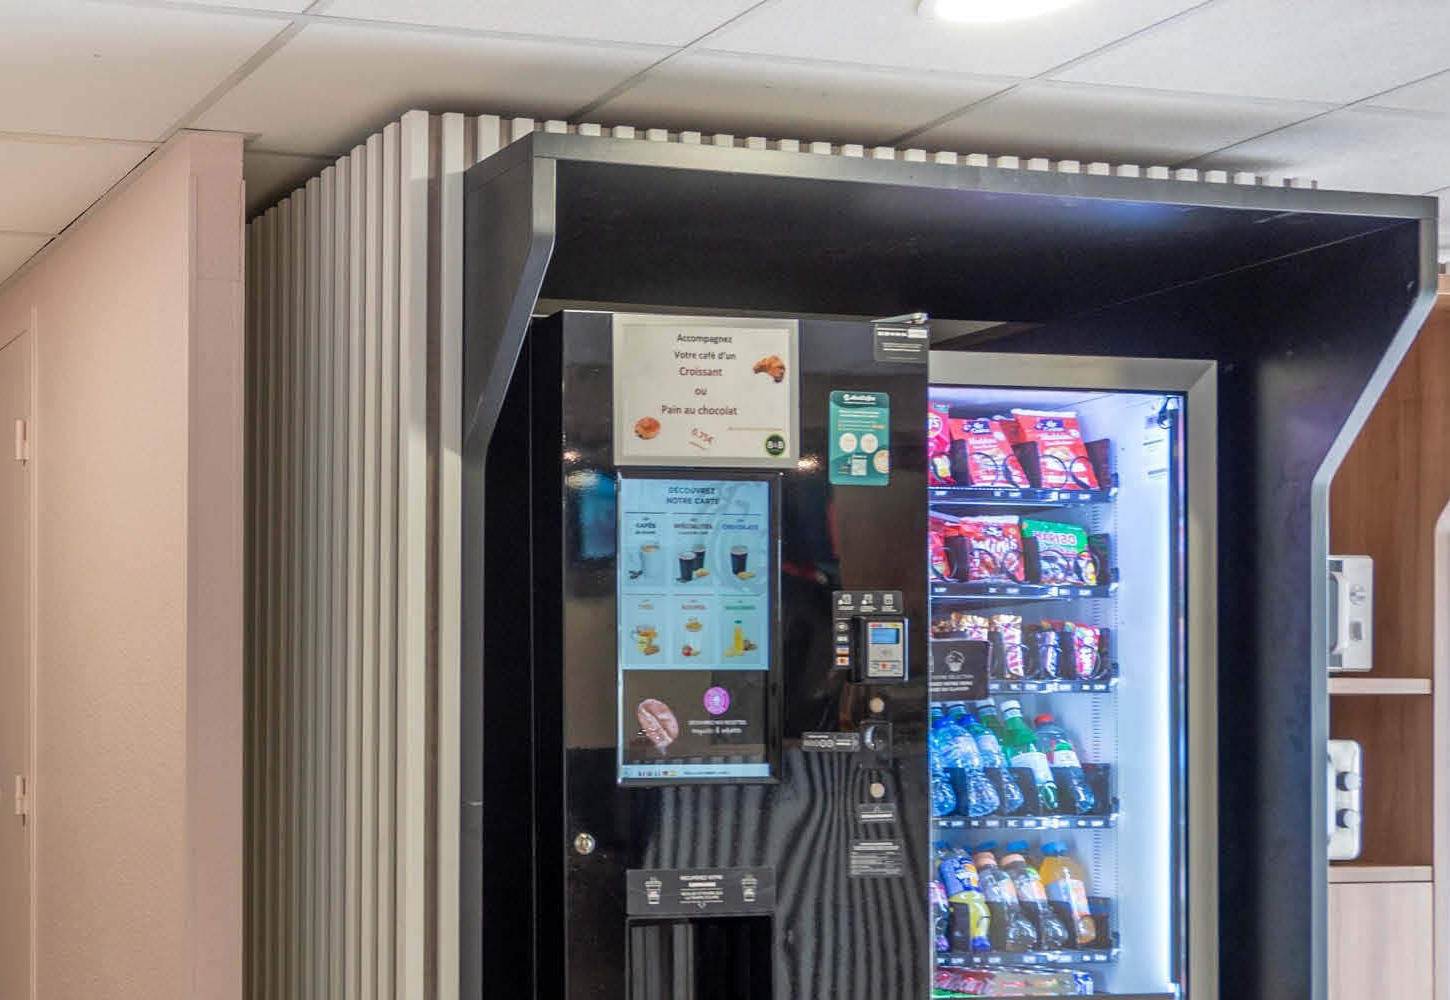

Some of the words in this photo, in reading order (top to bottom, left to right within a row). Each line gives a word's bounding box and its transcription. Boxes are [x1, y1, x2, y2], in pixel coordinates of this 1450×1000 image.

[676, 333, 733, 345] Accompagnez
[674, 351, 697, 360] Votre
[698, 351, 716, 360] café
[718, 351, 737, 361] d'un
[678, 366, 723, 377] Croissant
[694, 387, 708, 396] ou
[661, 404, 682, 415] Pain
[683, 406, 696, 415] au
[697, 404, 738, 416] chocolat
